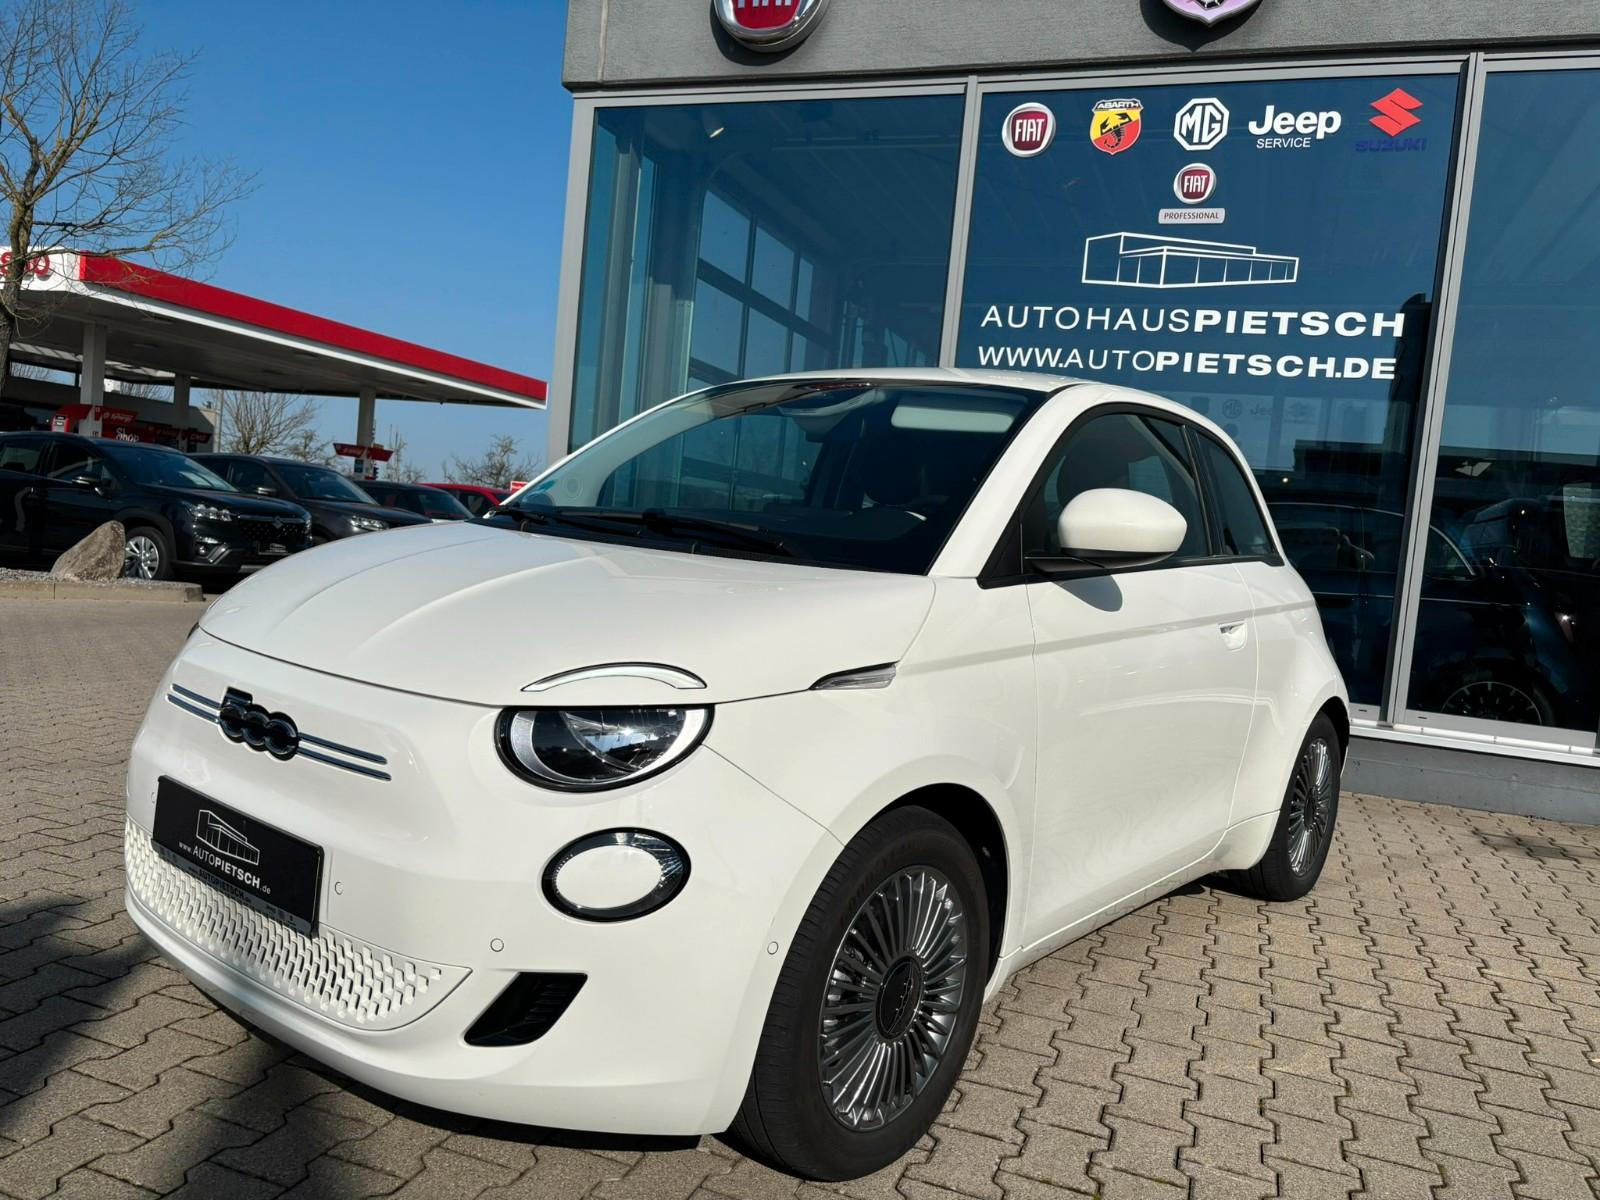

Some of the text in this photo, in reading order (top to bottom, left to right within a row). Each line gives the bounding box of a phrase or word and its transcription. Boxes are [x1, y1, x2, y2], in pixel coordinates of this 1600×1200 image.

[1096, 100, 1139, 110] ABARTH
[1014, 118, 1045, 142] FIAT
[1179, 104, 1223, 145] MG
[1248, 104, 1342, 139] Jeep
[1256, 137, 1312, 149] SERVICE
[1355, 138, 1428, 152] SUZUKI
[1183, 174, 1208, 193] FIAT
[1163, 210, 1220, 221] PROFESSIONAL
[980, 305, 1405, 338] AUTOHAUSPIETSCH
[978, 346, 1397, 380] WWW.AUTOPIETSCH.DE
[219, 686, 299, 761] 500
